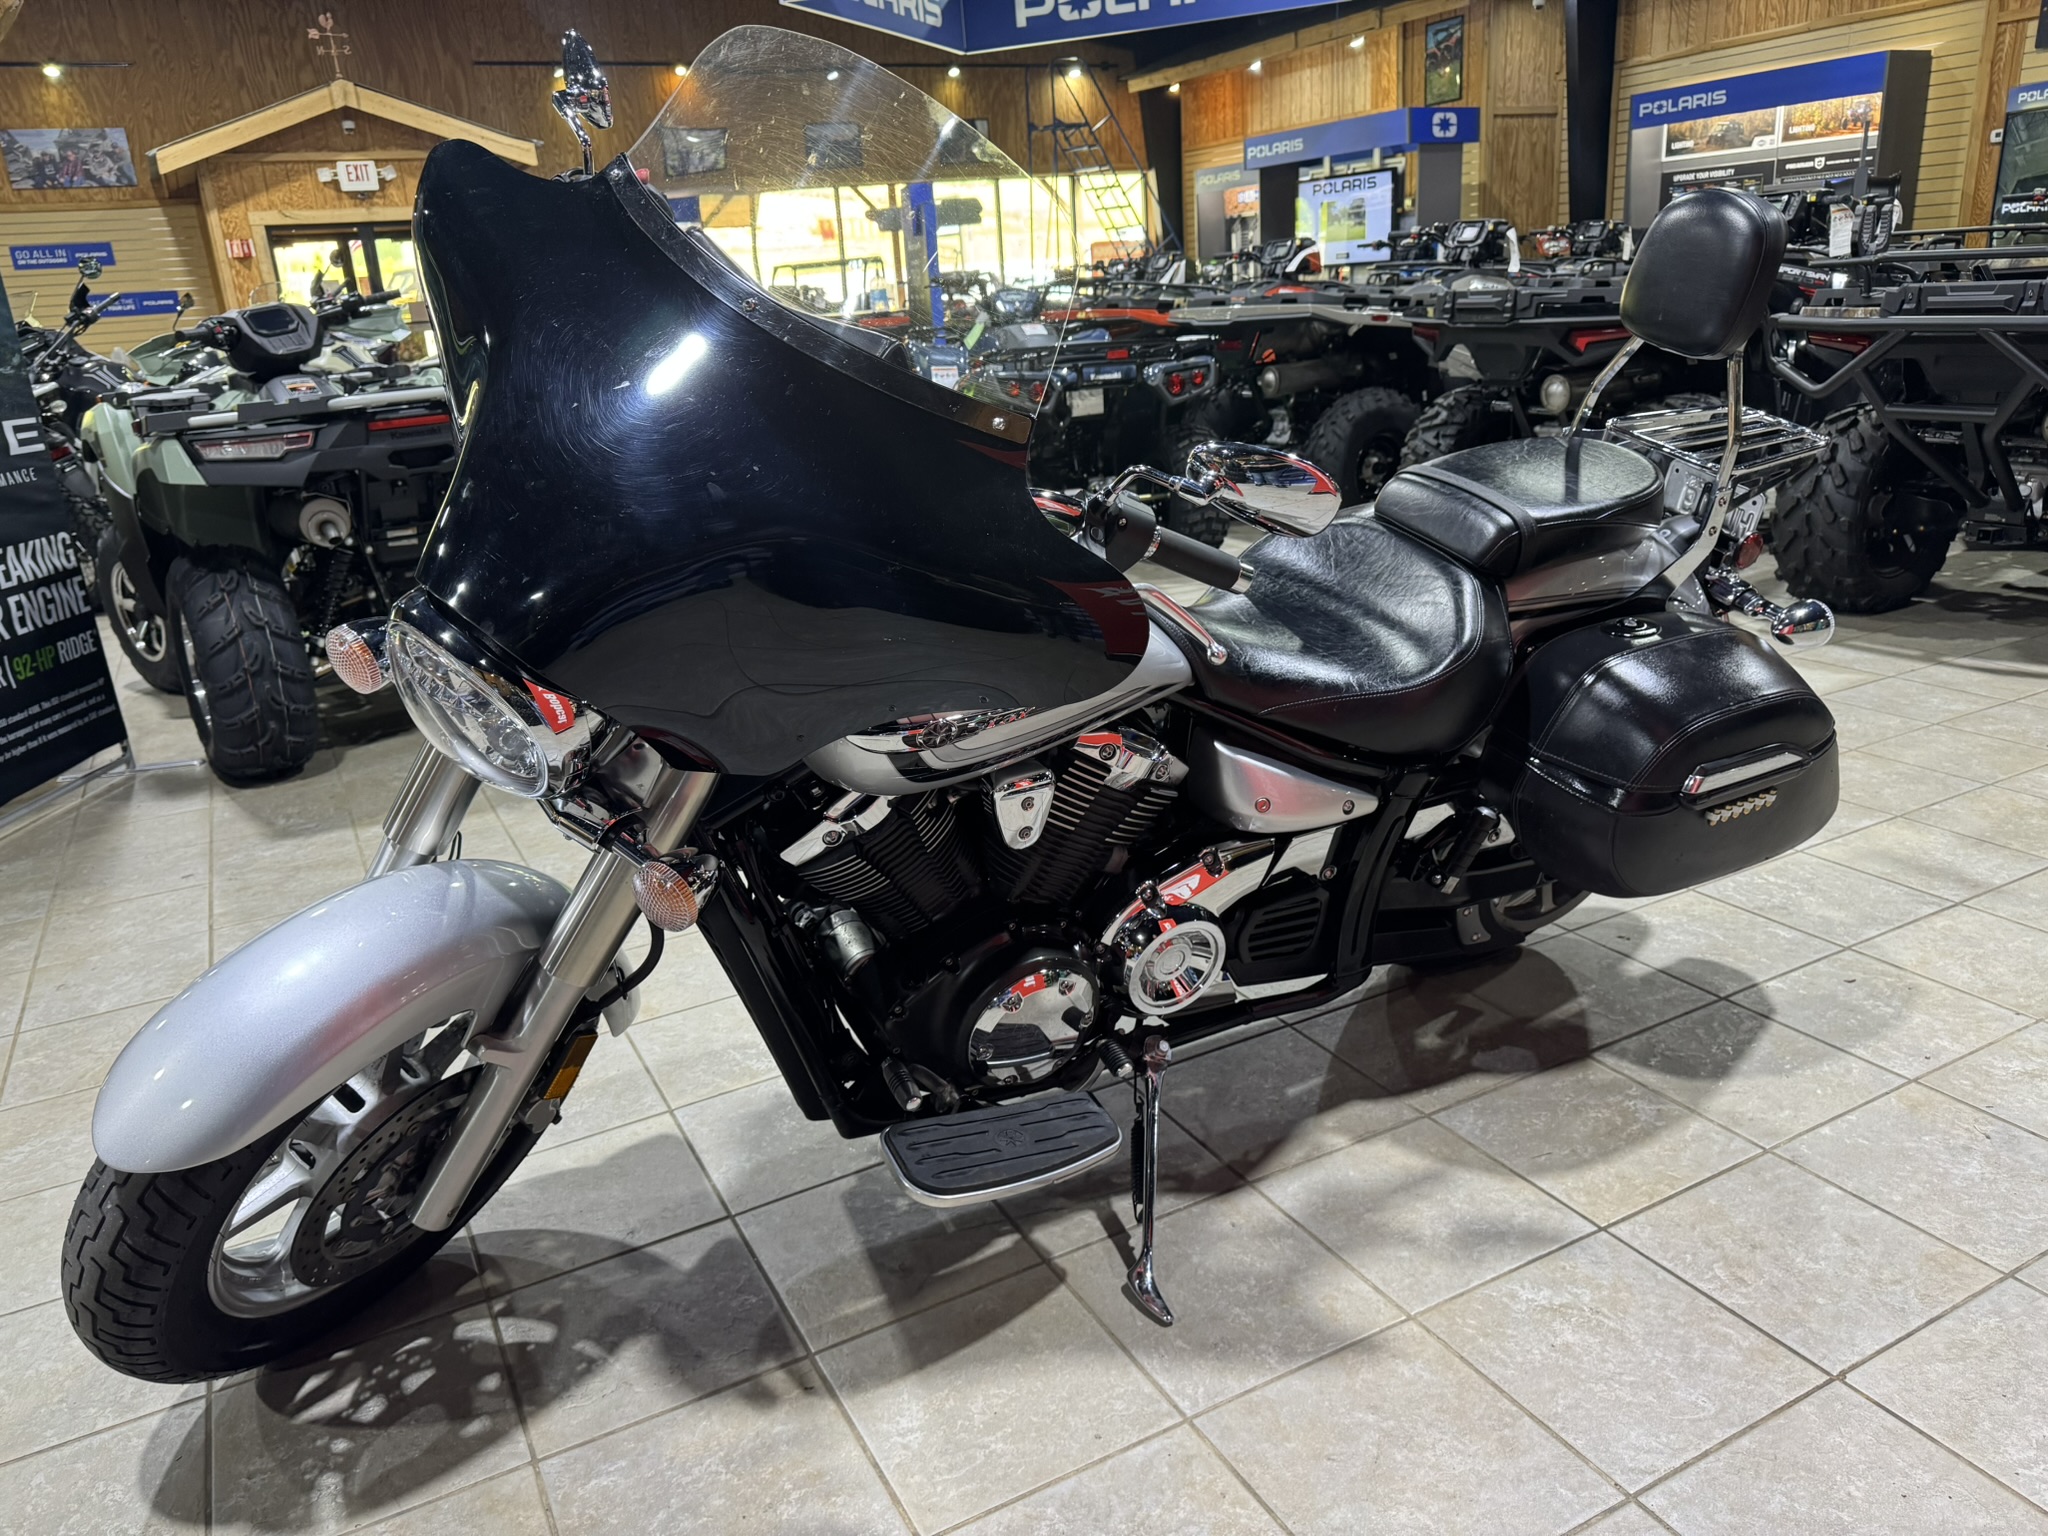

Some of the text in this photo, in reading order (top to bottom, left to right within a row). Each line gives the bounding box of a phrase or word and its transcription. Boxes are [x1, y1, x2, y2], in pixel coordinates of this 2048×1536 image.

[1639, 90, 1727, 118] POLARIS
[1247, 138, 1304, 160] POLARIS
[346, 164, 370, 182] EXIT
[1313, 176, 1377, 196] POLARIS
[15, 248, 67, 260] GO ALL IN
[7, 575, 92, 636] ENGINE
[13, 645, 56, 681] 92-HP
